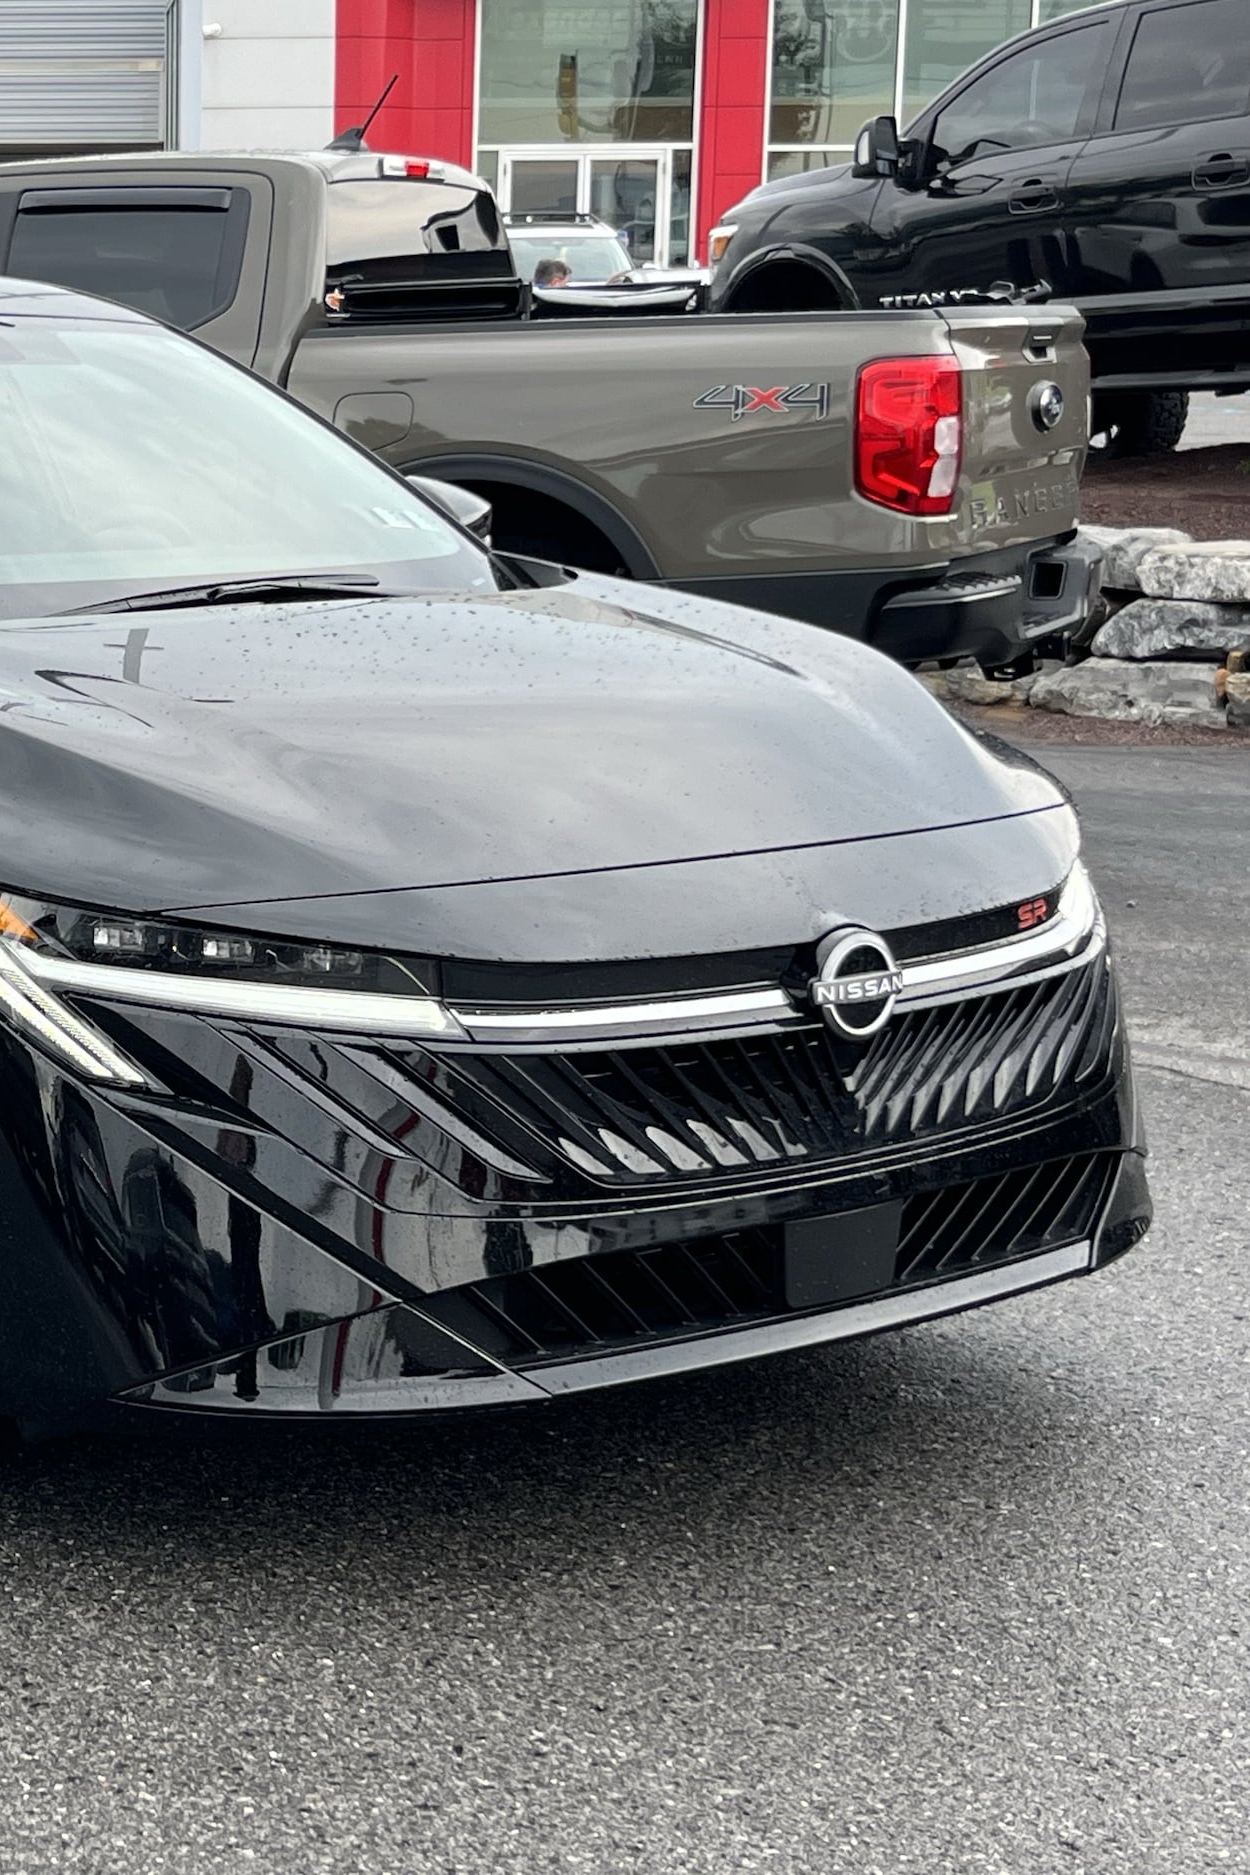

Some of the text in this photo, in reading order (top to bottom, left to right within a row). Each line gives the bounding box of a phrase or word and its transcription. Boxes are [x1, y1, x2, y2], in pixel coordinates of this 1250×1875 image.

[879, 291, 945, 308] TITAN
[1017, 898, 1048, 929] SR
[817, 974, 902, 1003] NISSAN
